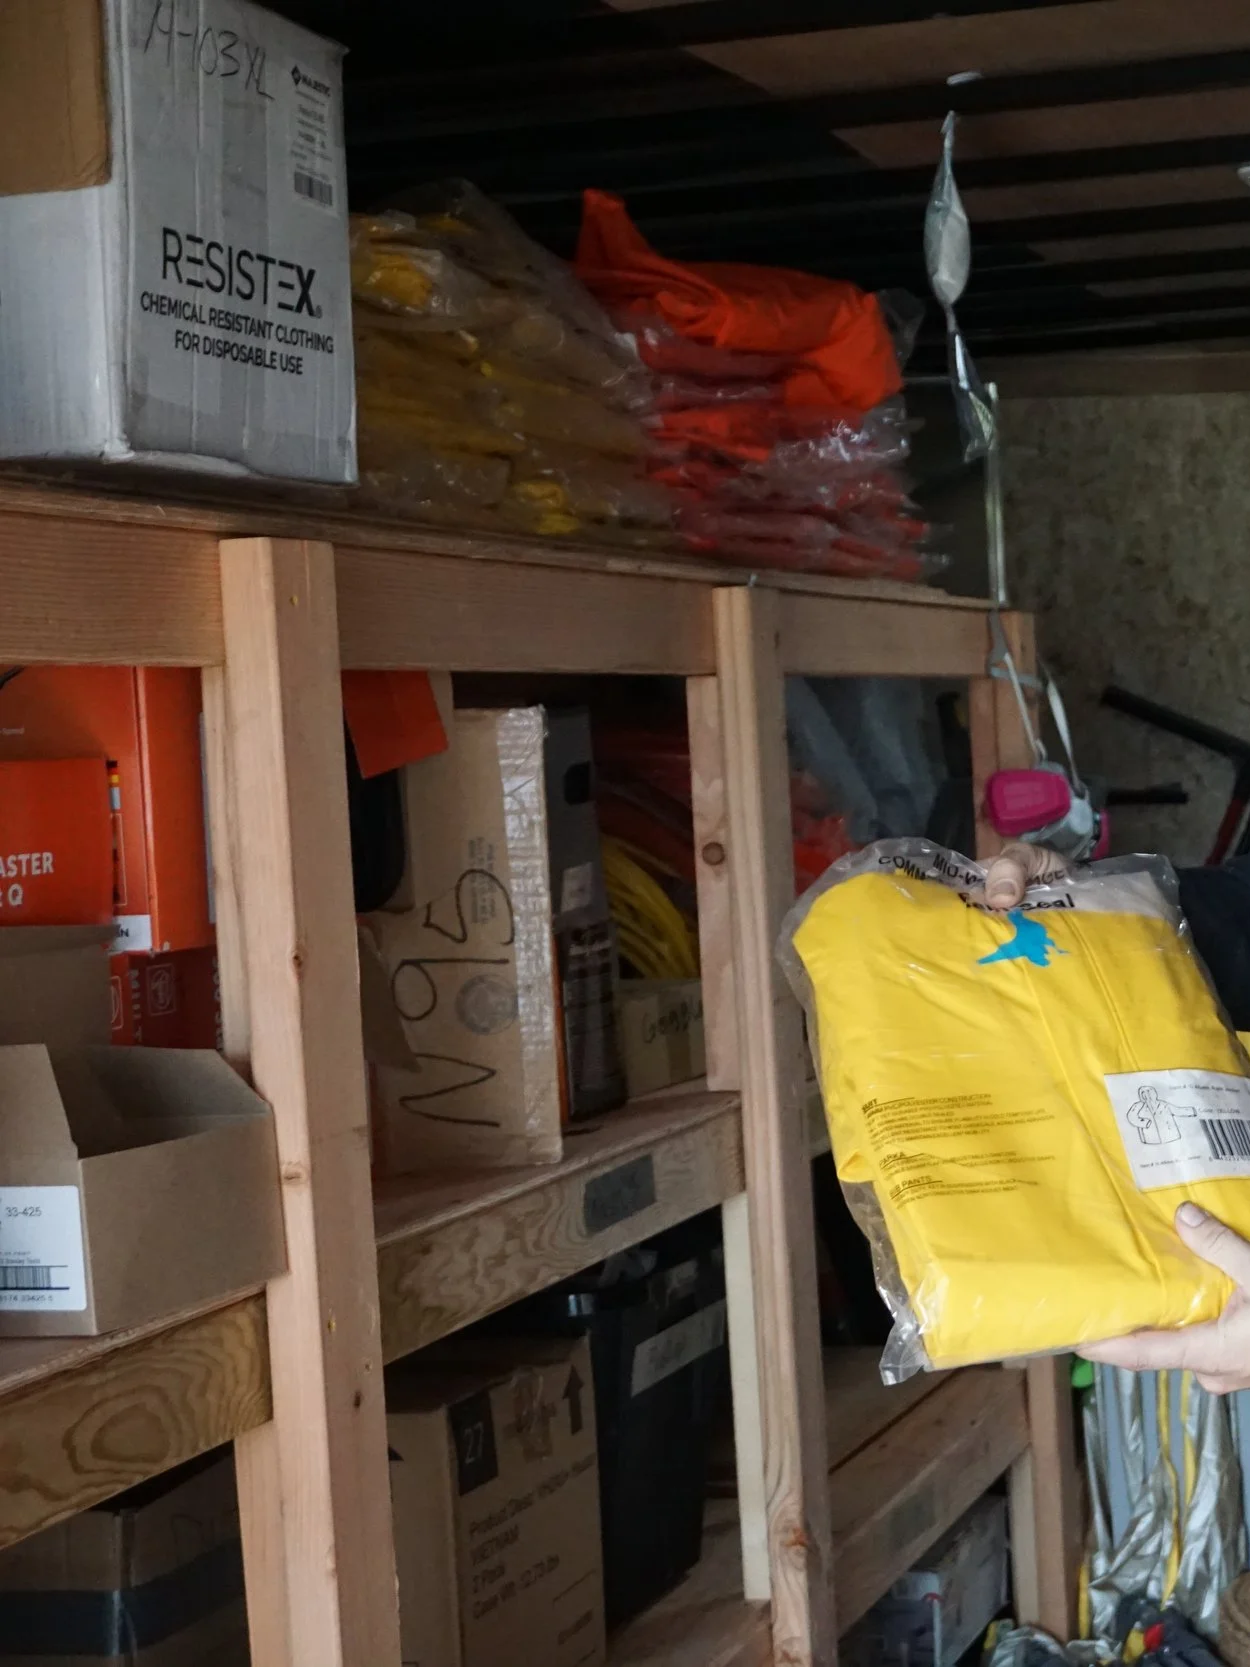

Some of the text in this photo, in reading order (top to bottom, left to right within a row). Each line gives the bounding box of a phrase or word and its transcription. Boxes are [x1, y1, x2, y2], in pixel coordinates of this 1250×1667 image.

[162, 226, 316, 317] RESISTEX
[140, 291, 335, 354] CHEMICAL RESISTANT CLOTHING
[175, 329, 303, 375] FOR DISPOSABLE USE
[879, 1151, 906, 1168] PARKA
[901, 1175, 932, 1188] PANTS
[5, 1206, 42, 1217] 33-425
[463, 1421, 485, 1464] 27
